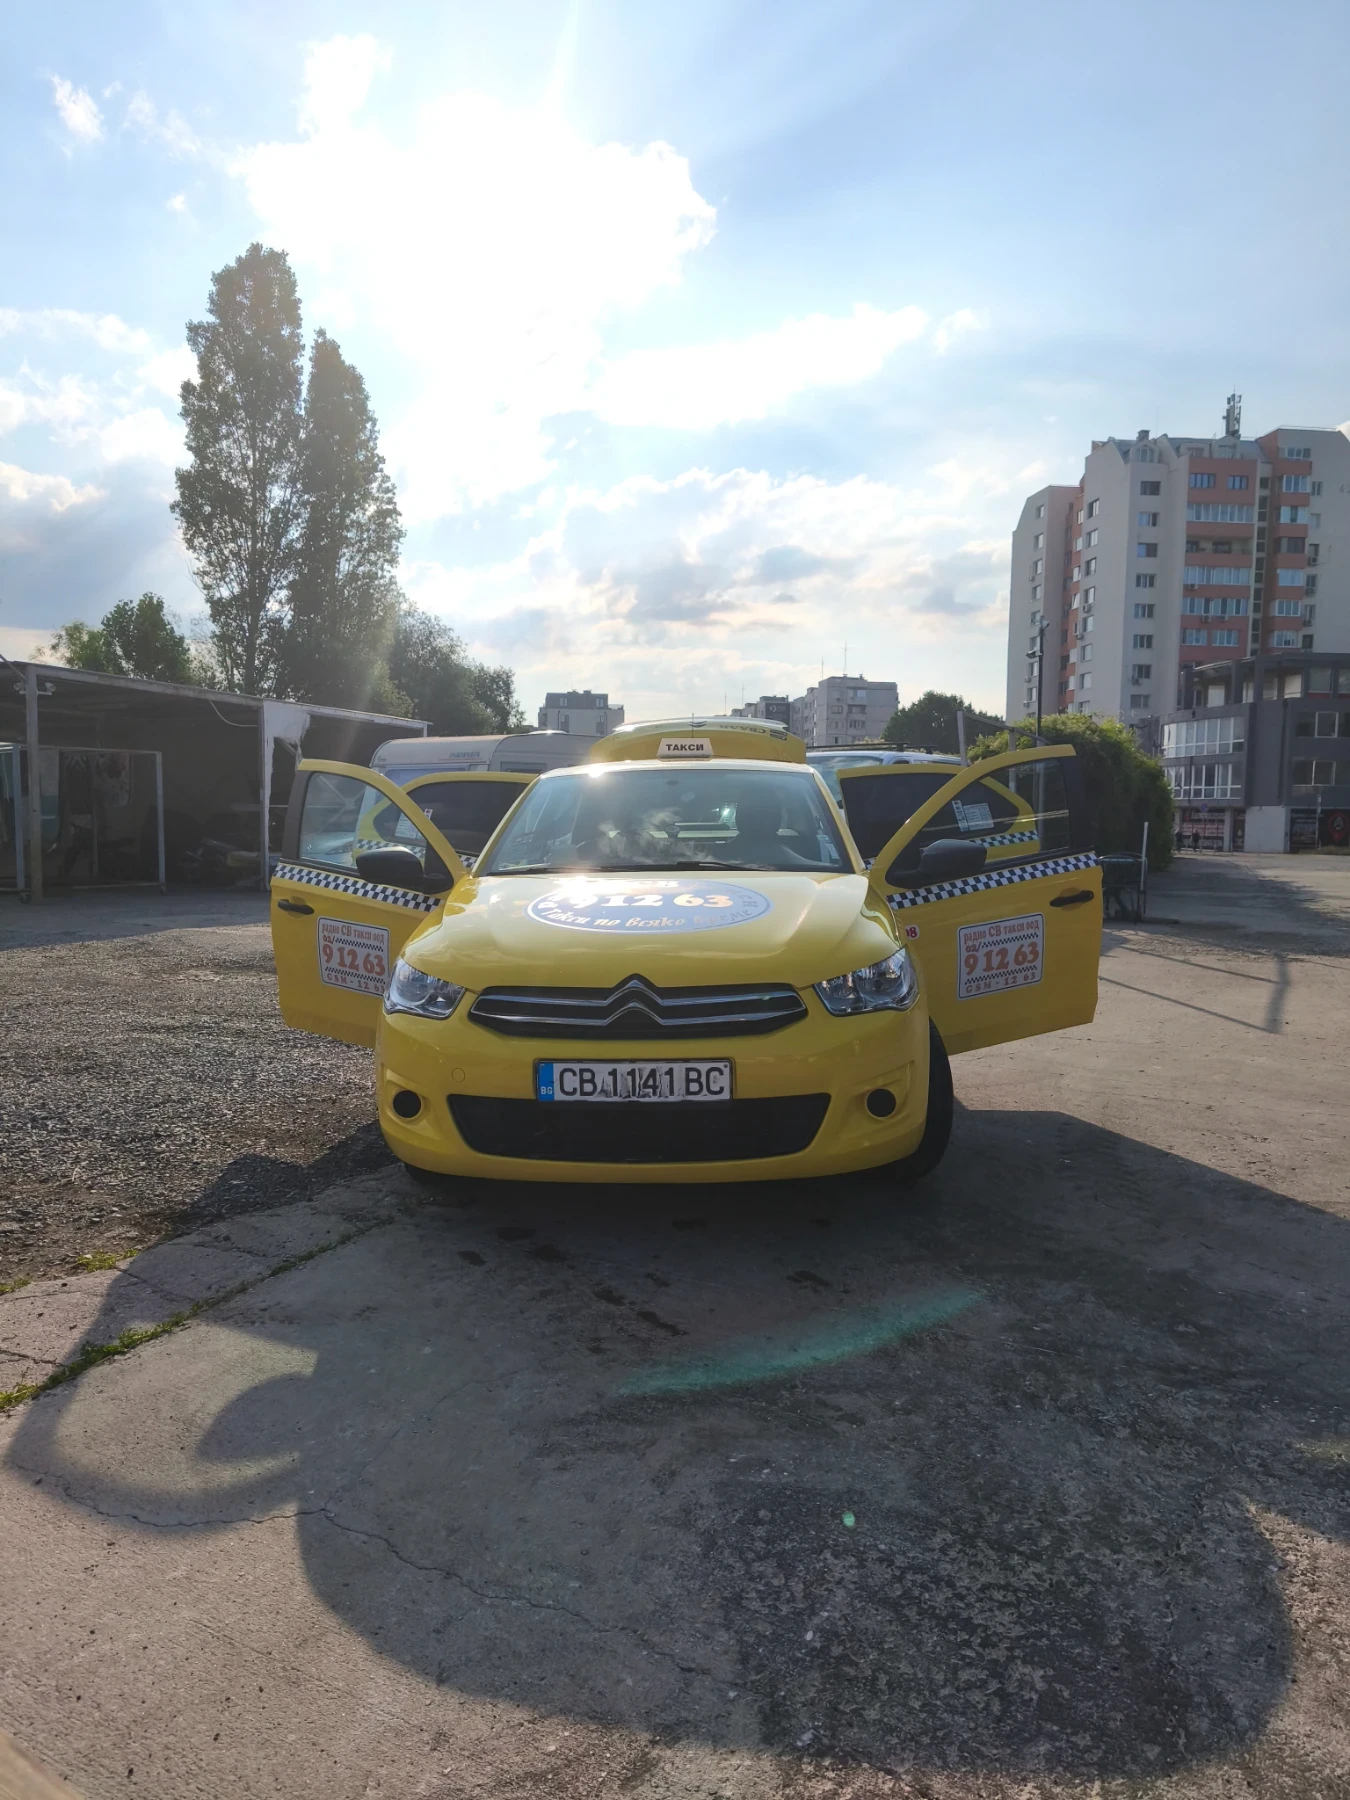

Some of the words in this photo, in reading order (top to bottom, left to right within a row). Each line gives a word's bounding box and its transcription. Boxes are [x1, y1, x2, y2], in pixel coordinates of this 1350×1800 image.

[666, 743, 704, 752] ТАКСИ
[673, 894, 734, 908] 63
[559, 1067, 597, 1097] CB
[685, 1067, 725, 1096] BC
[541, 1086, 553, 1095] BG
